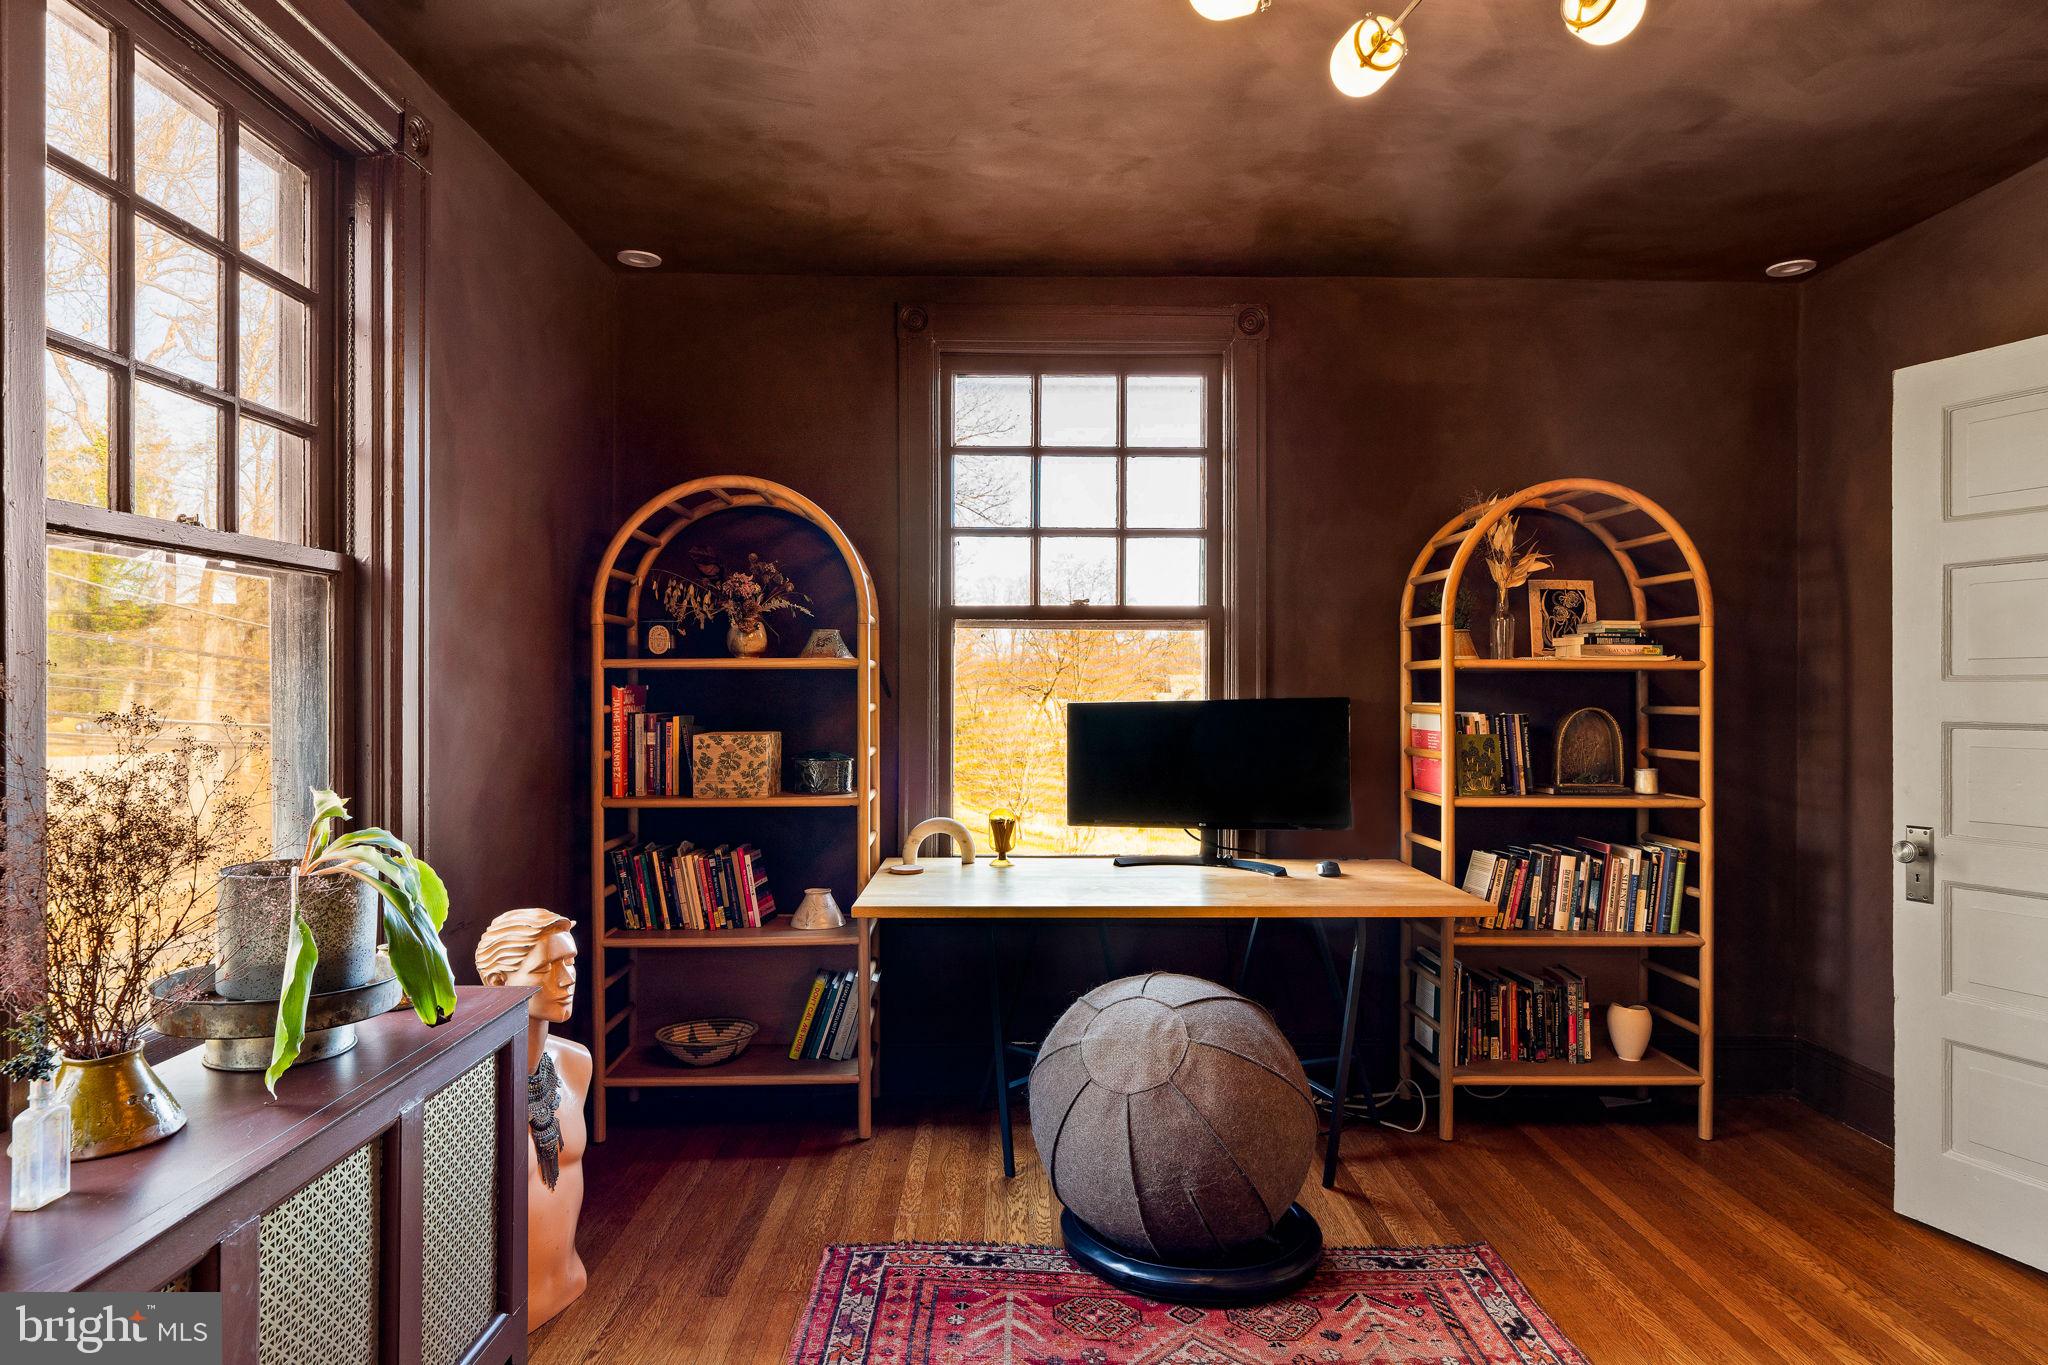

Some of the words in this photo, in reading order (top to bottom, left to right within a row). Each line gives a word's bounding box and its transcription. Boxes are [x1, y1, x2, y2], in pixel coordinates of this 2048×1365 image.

[612, 697, 621, 723] JAIME
[612, 725, 621, 778] HERNANDEZ
[1619, 873, 1628, 911] SILENCE
[840, 983, 851, 1001] FEMALE
[804, 1006, 813, 1022] CALL
[800, 1022, 809, 1034] ME
[794, 1033, 804, 1053] HOME
